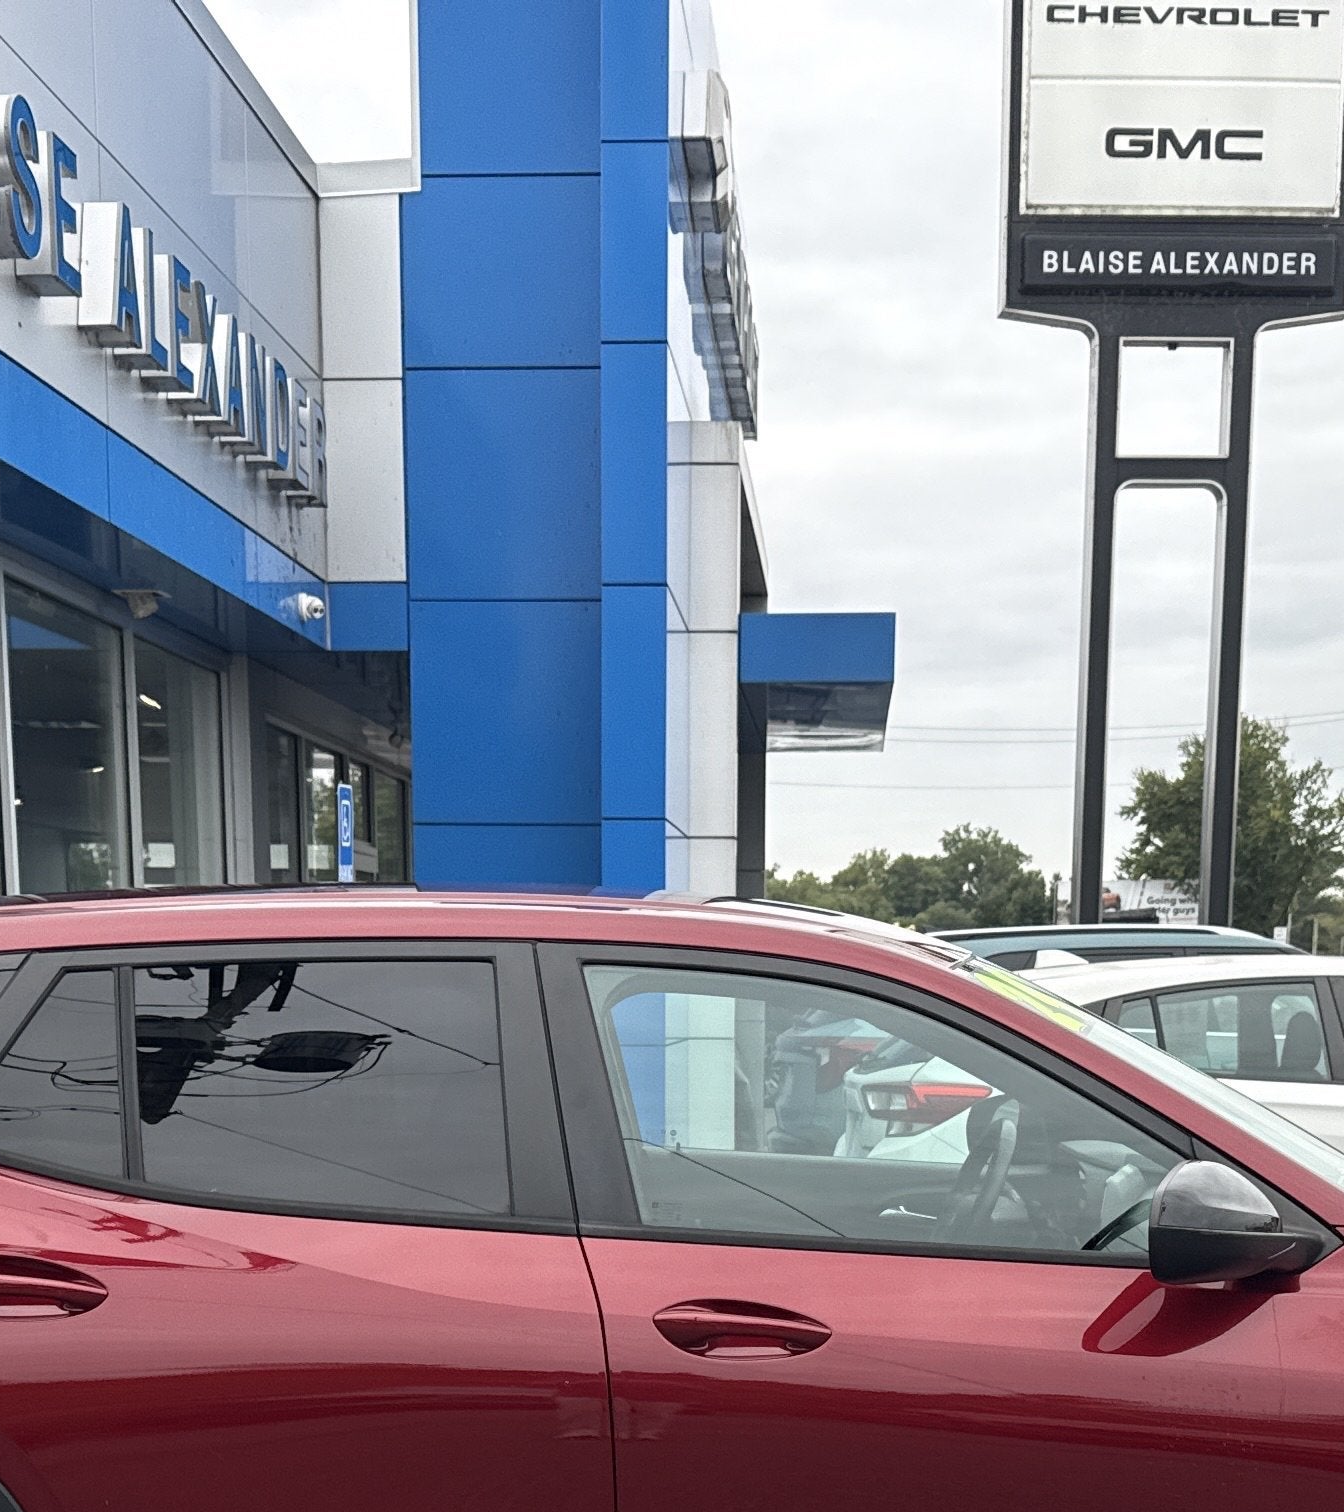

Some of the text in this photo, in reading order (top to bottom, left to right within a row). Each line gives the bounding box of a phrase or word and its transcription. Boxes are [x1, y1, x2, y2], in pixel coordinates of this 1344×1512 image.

[1045, 4, 1330, 28] CHEVROLET
[1104, 126, 1264, 161] GMC
[1041, 249, 1317, 276] BLAISE ALEXANDER
[96, 202, 328, 508] ALEXANDER
[1146, 895, 1177, 907] Going
[1173, 907, 1196, 916] guys
